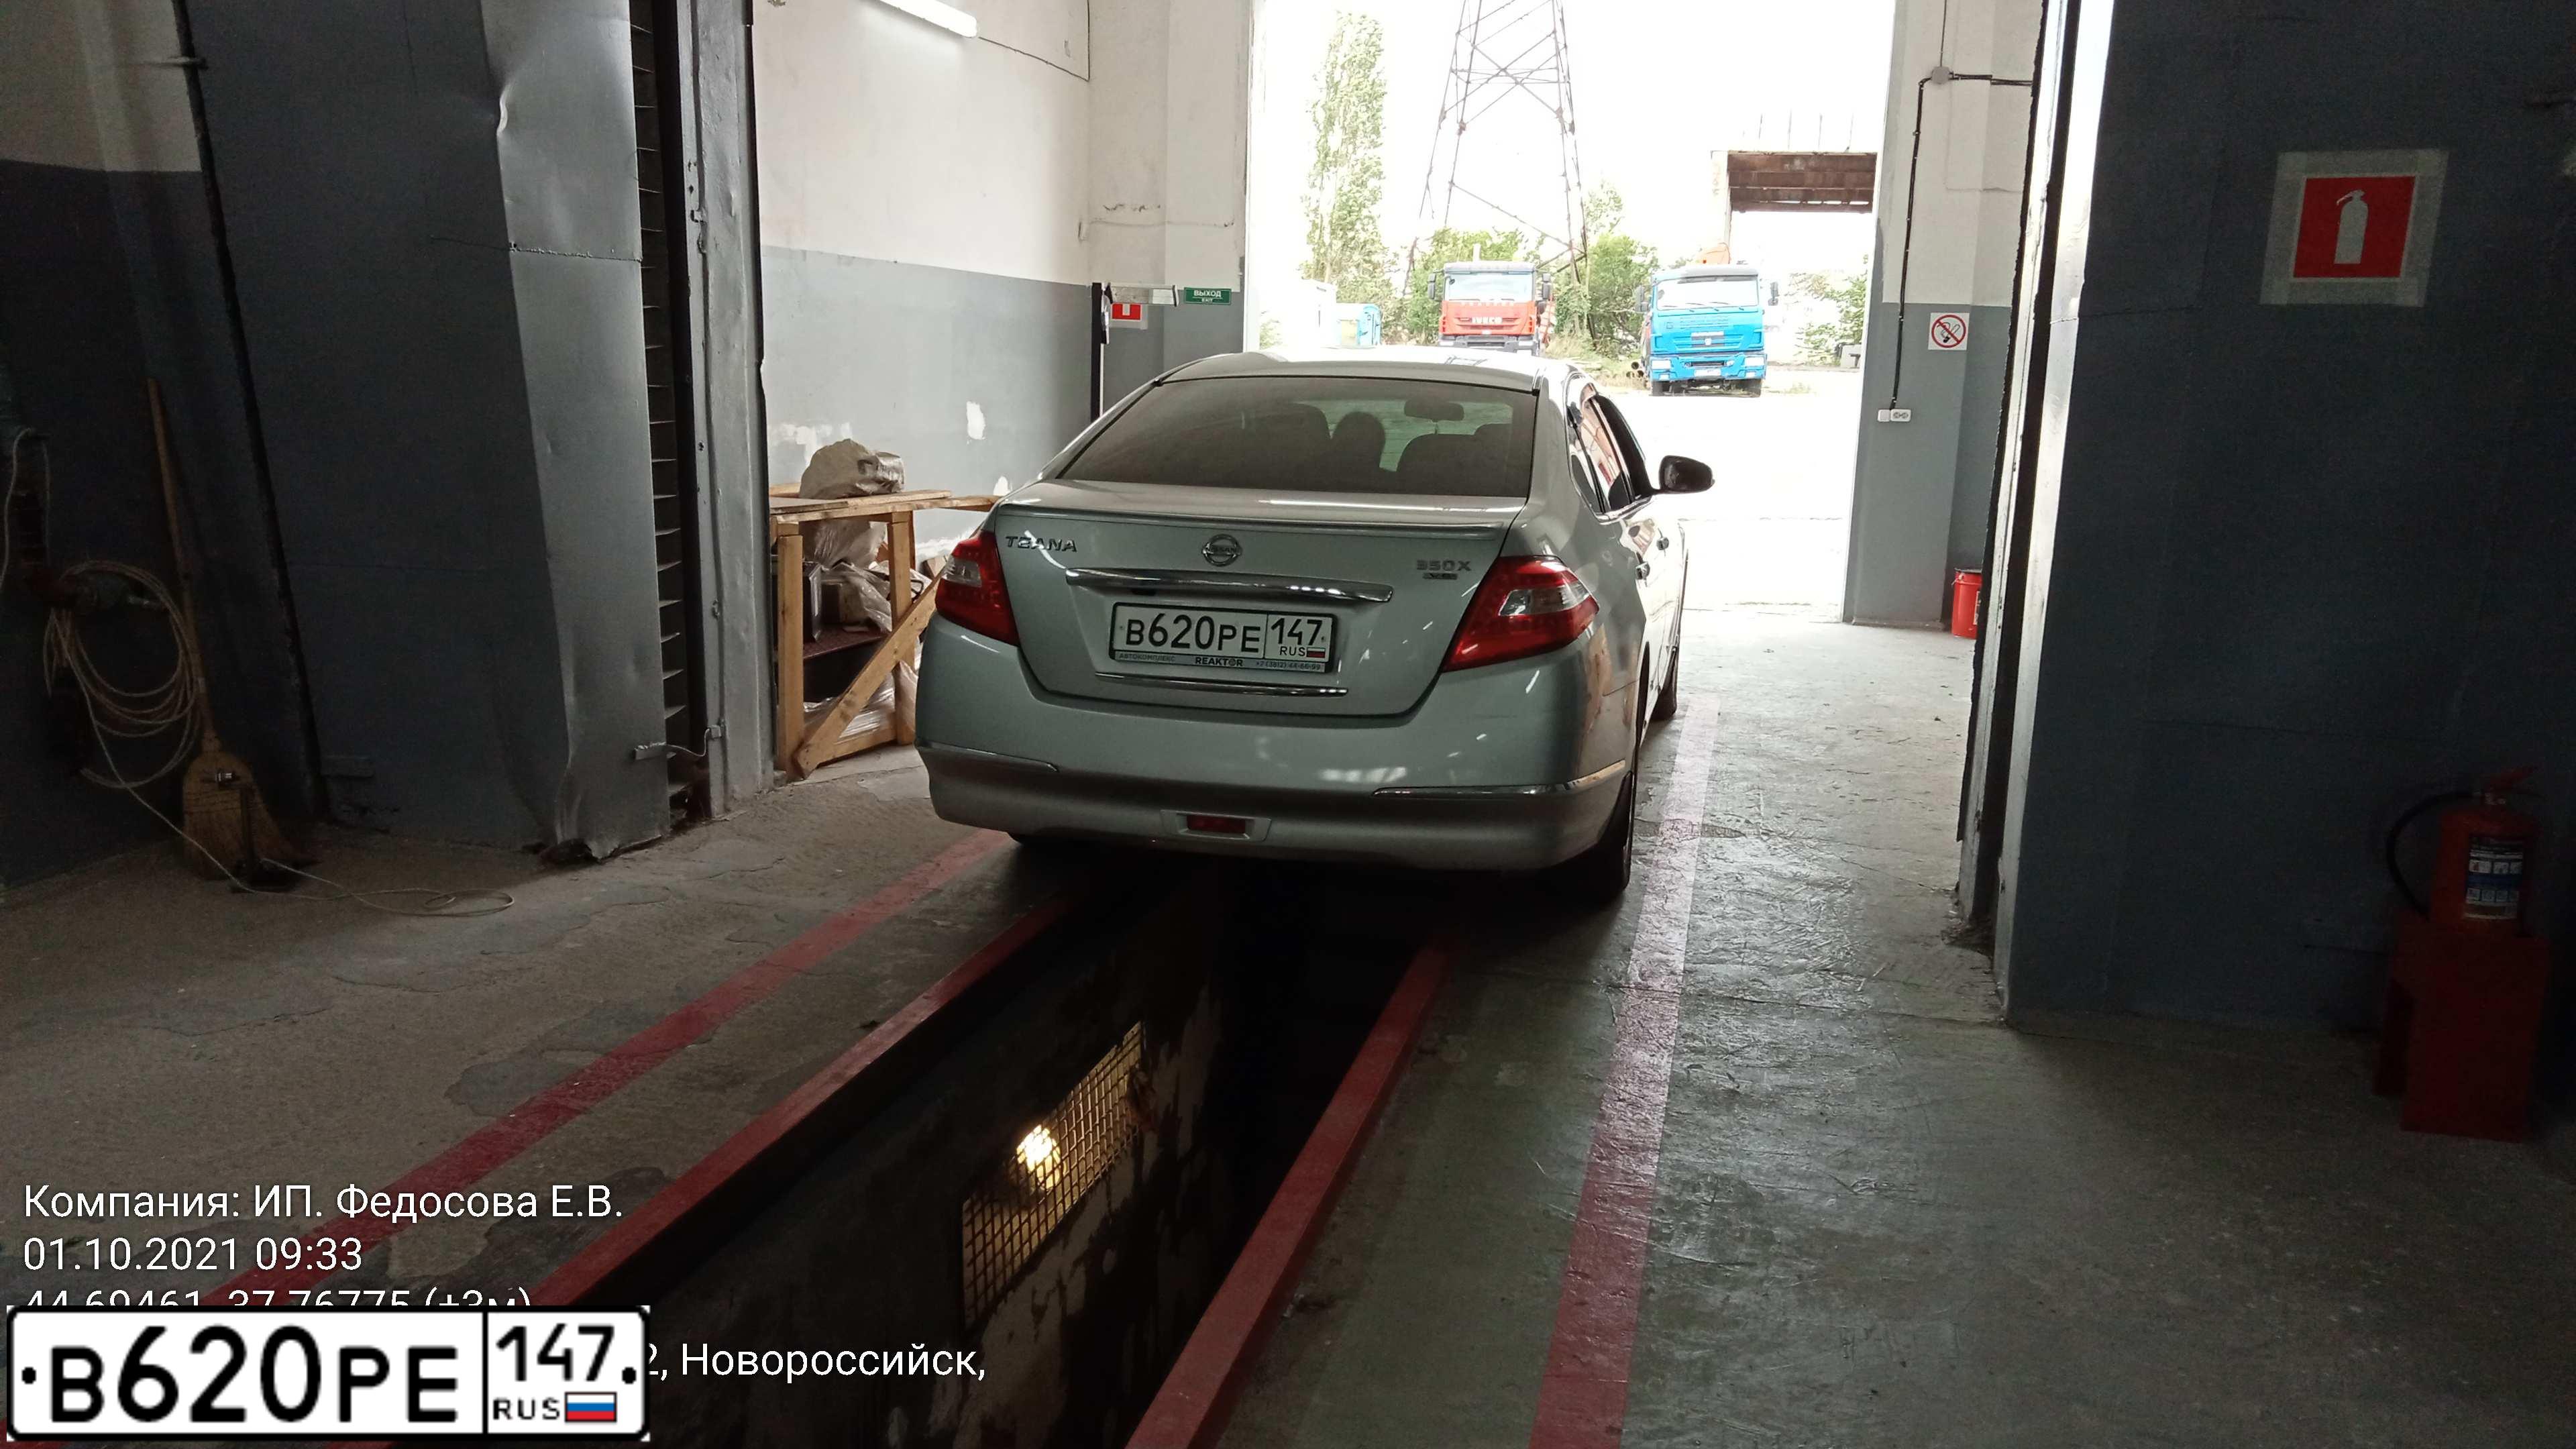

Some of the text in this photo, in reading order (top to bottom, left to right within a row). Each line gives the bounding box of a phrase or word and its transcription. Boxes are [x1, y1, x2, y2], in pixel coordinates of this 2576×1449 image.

[1194, 290, 1222, 298] ВЫХОД
[1006, 536, 1078, 553] TEANA
[1126, 613, 1323, 653] В620РЕ 147
[1279, 645, 1307, 657] RUS
[1119, 653, 1175, 661] АВТОКОМПЛЕКС
[1194, 657, 1243, 667] REAKTOR
